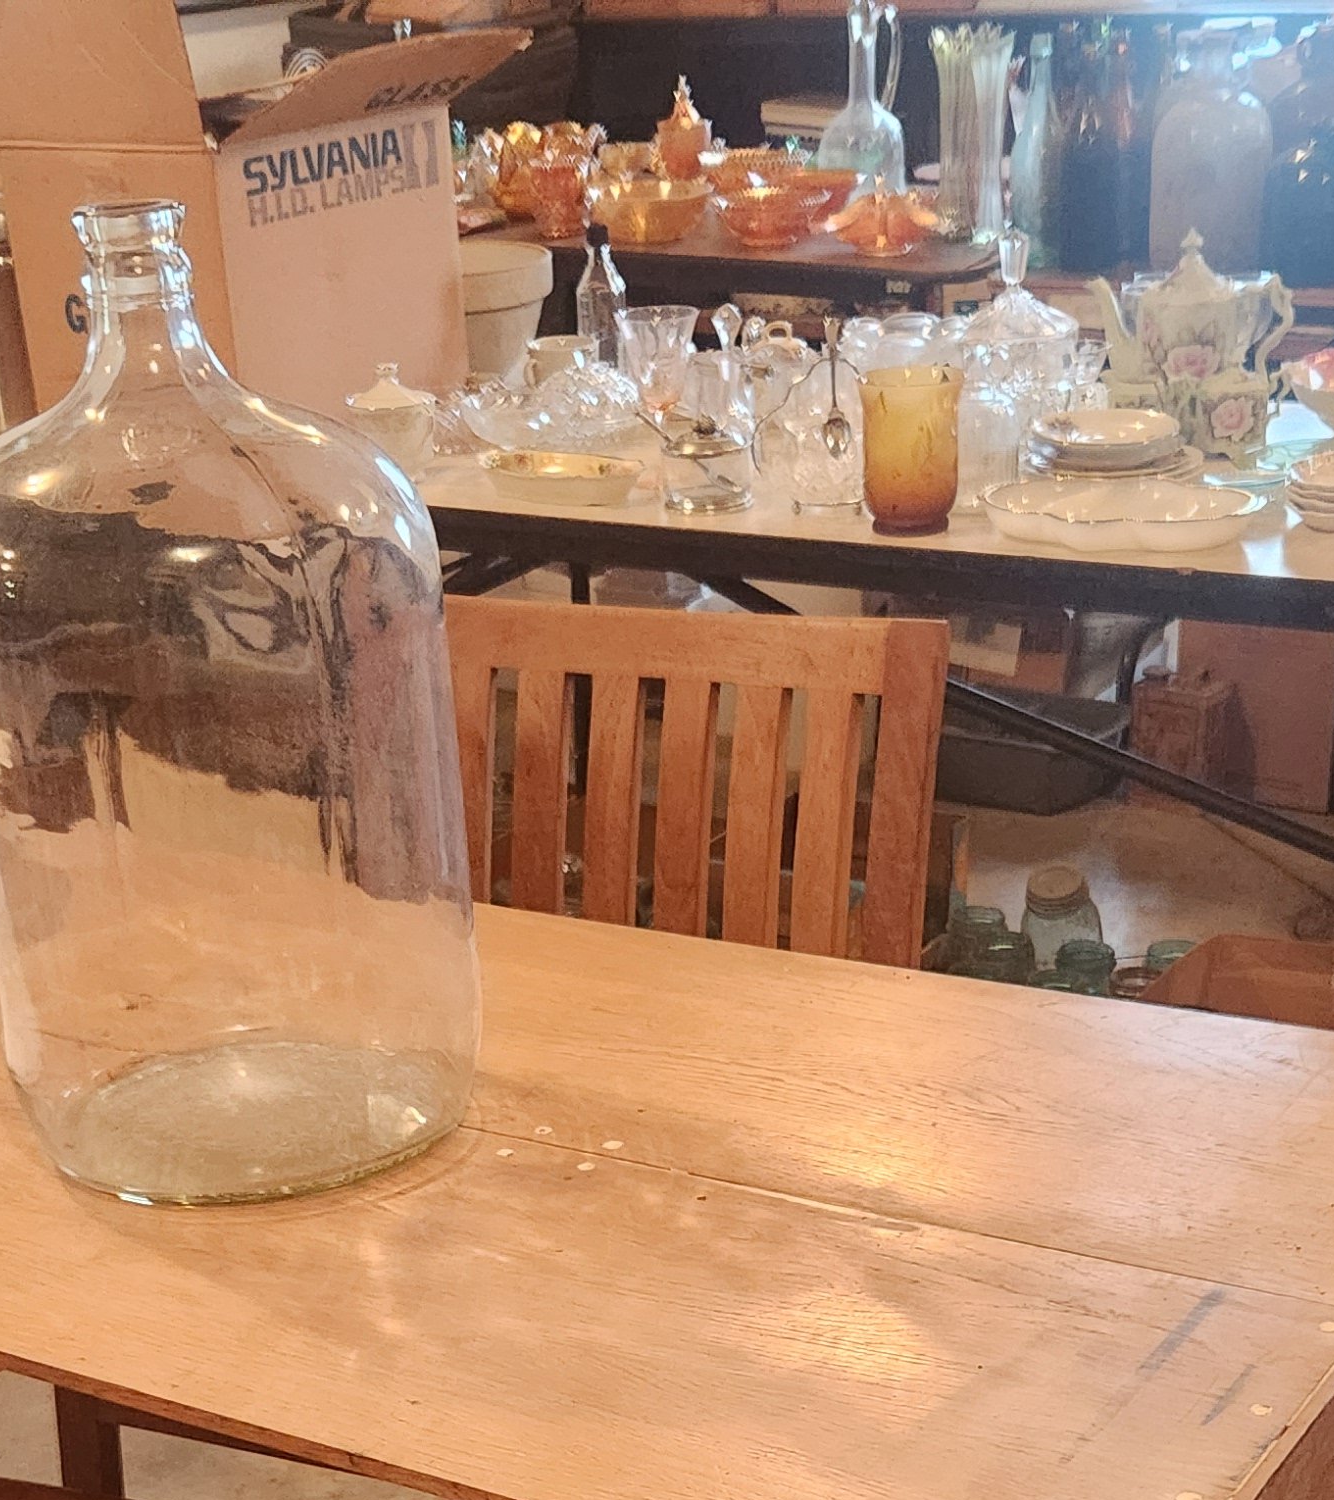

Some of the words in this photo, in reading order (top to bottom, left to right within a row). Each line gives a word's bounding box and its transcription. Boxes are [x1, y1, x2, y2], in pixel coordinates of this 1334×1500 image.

[242, 128, 403, 197] SYLVANIA
[247, 187, 316, 228] H.I.D.
[319, 165, 406, 211] LAMPS
